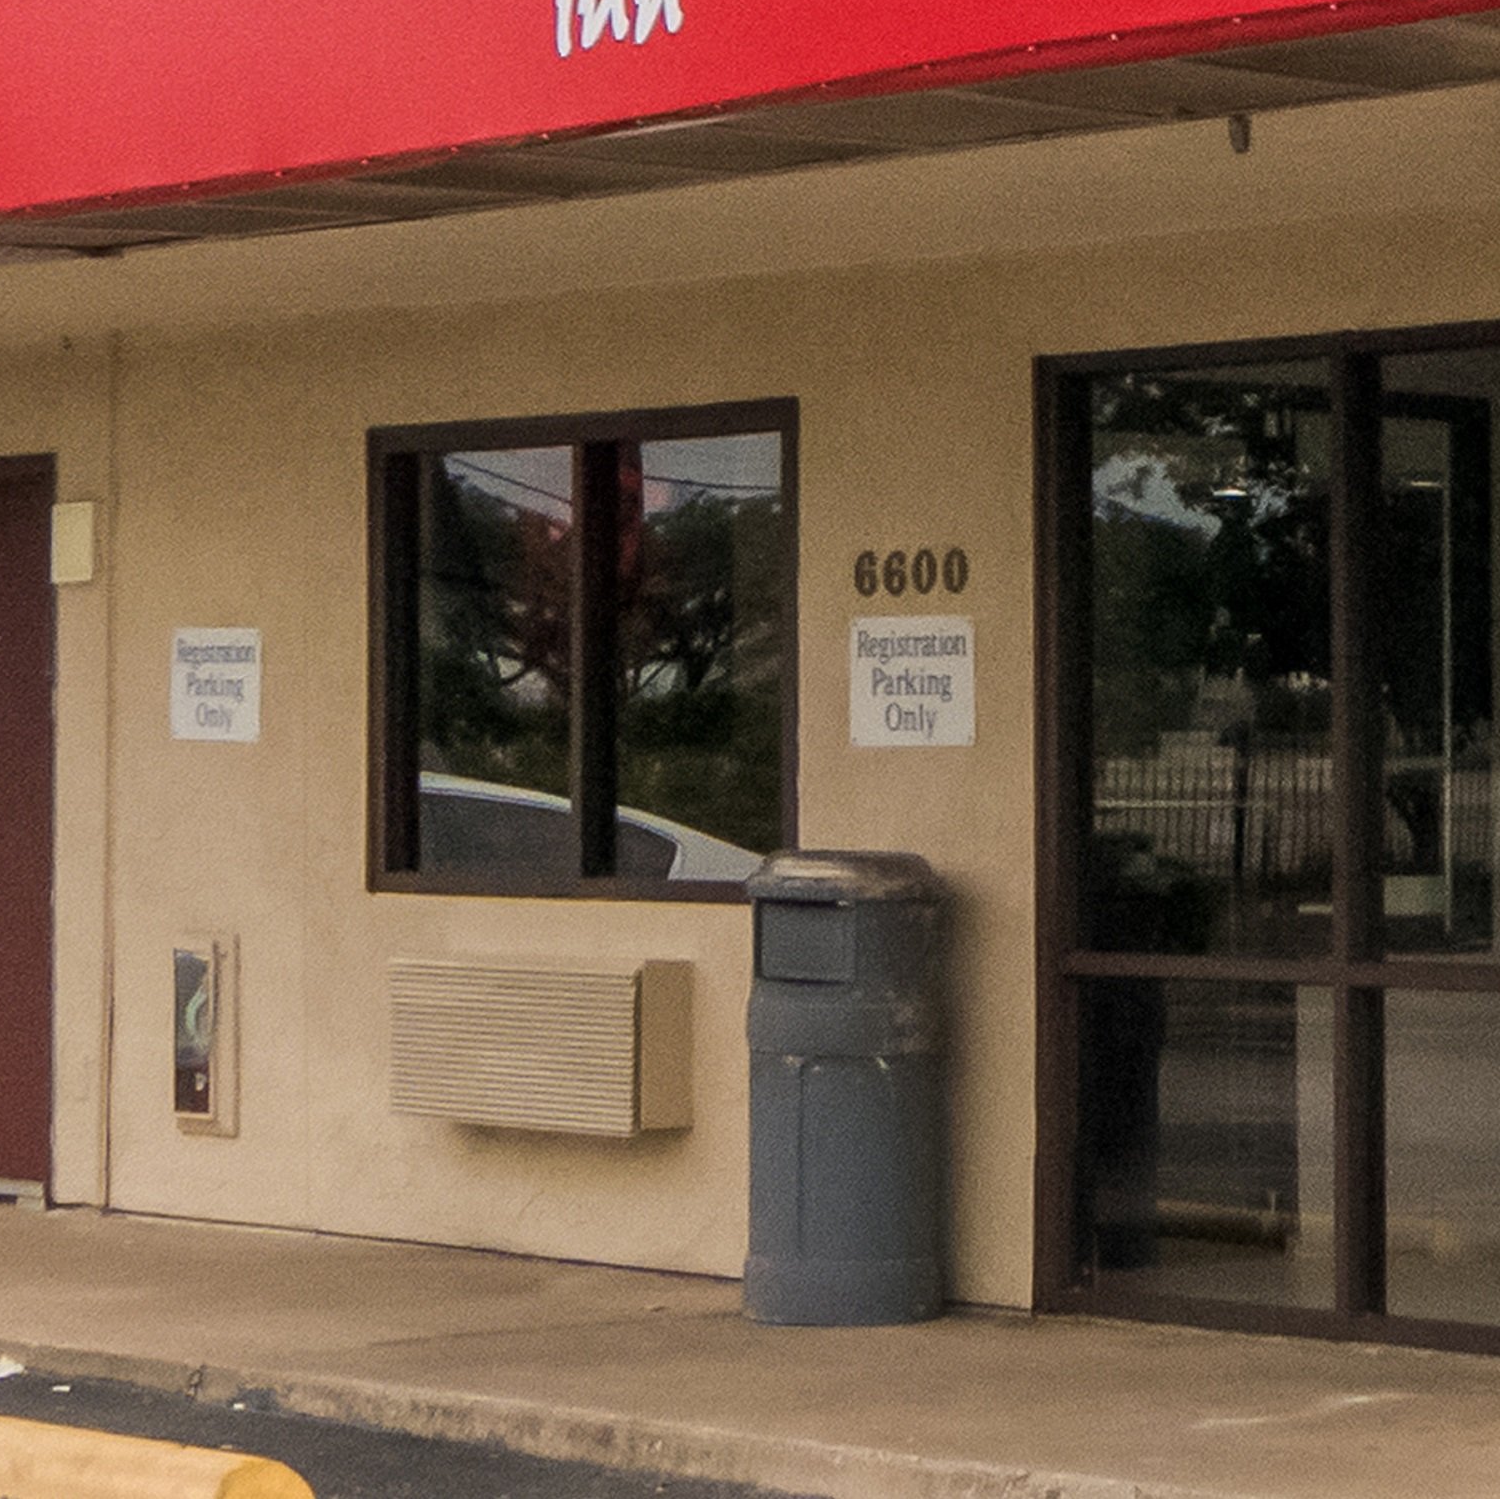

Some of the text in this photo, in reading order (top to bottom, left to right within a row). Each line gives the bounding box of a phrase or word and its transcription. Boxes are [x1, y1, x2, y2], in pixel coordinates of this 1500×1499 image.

[853, 548, 969, 596] 6600
[856, 629, 968, 665] Registration
[871, 666, 953, 701] Parking
[885, 702, 938, 738] Only
